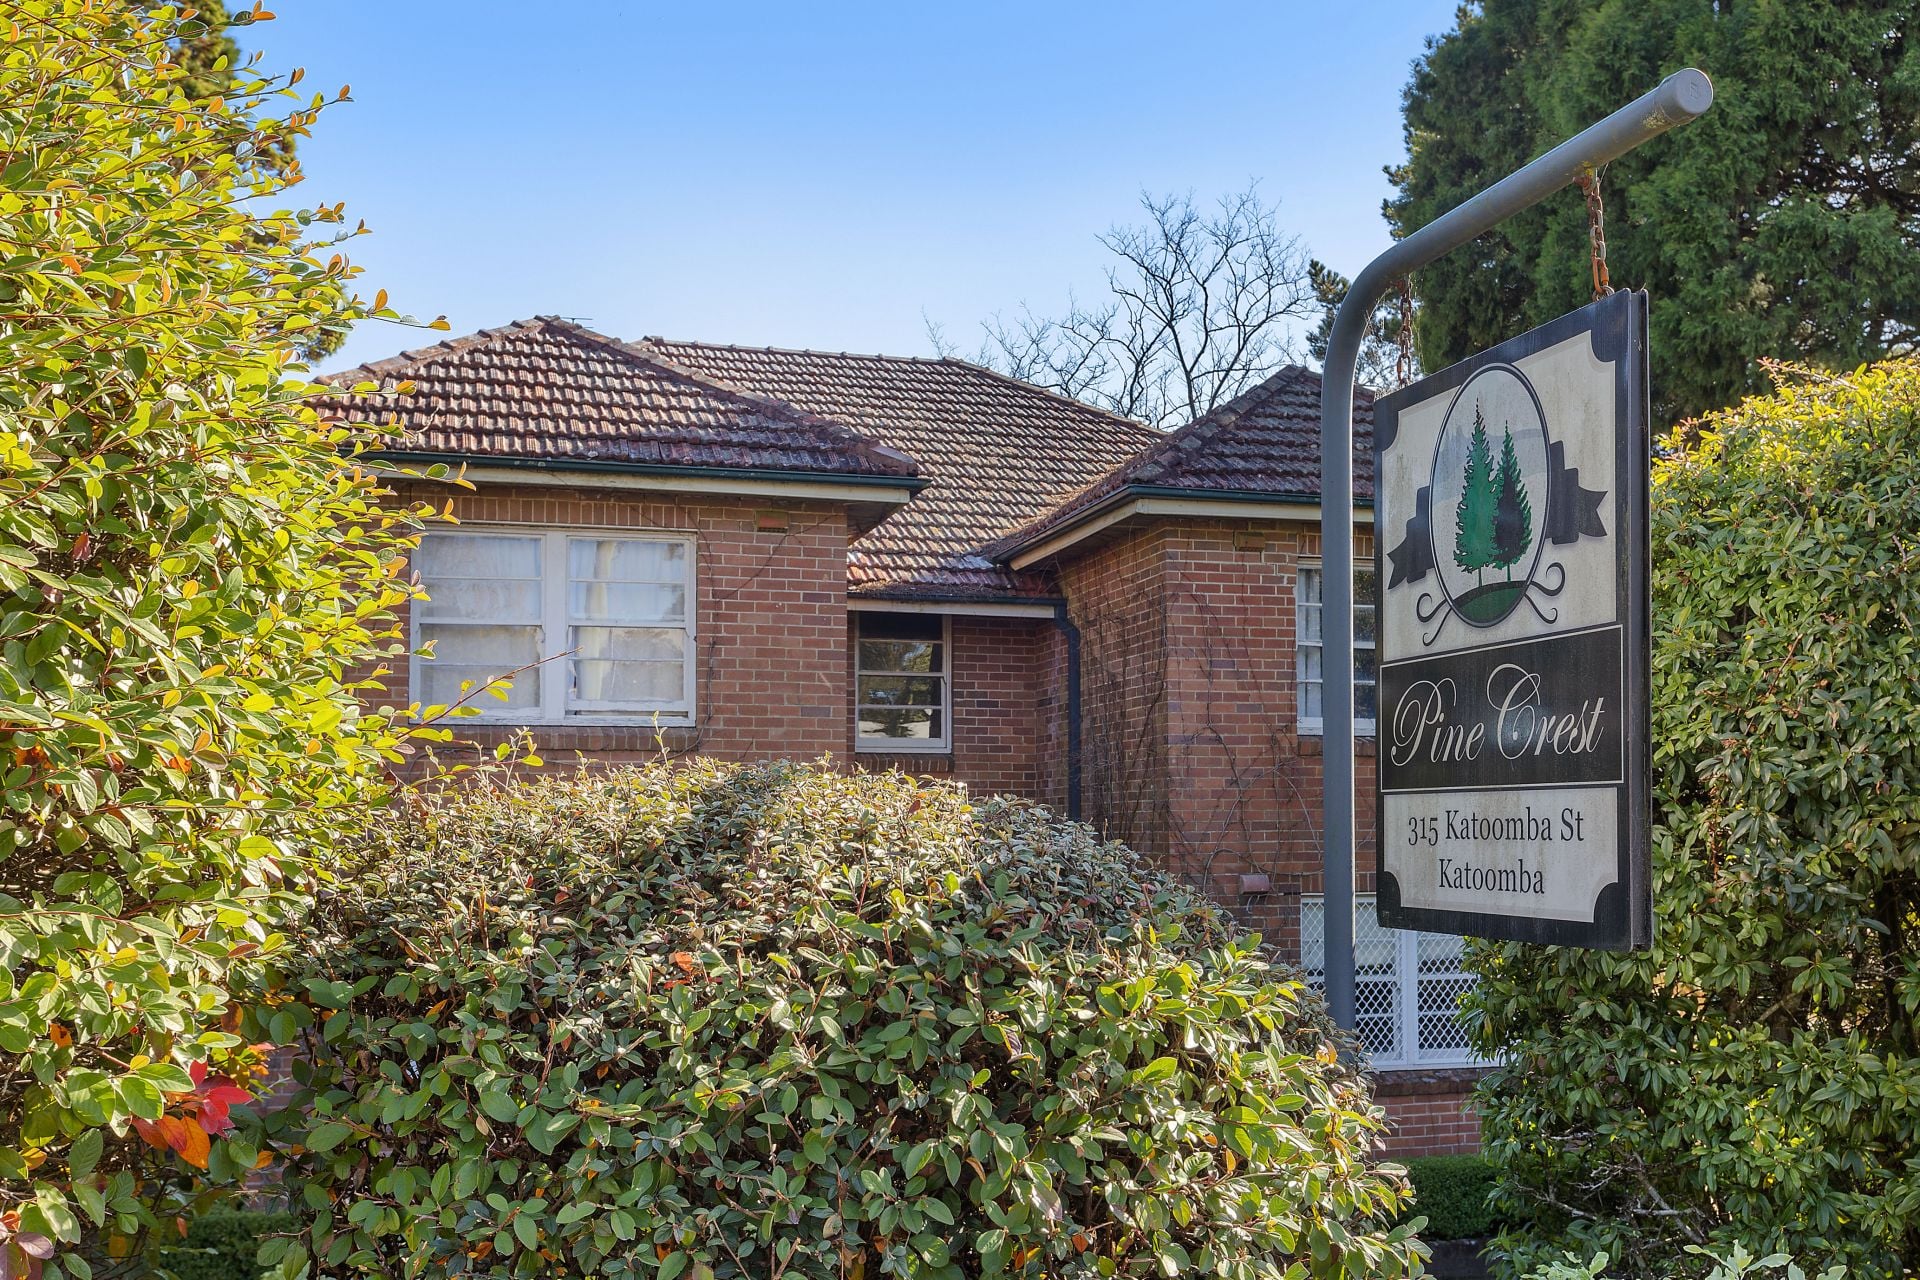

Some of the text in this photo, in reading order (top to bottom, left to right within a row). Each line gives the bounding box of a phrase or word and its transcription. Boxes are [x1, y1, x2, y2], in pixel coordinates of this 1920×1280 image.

[1391, 663, 1605, 766] Pine Crest
[1408, 806, 1584, 846] 315 Katoomba St
[1439, 858, 1545, 894] Katoomba
